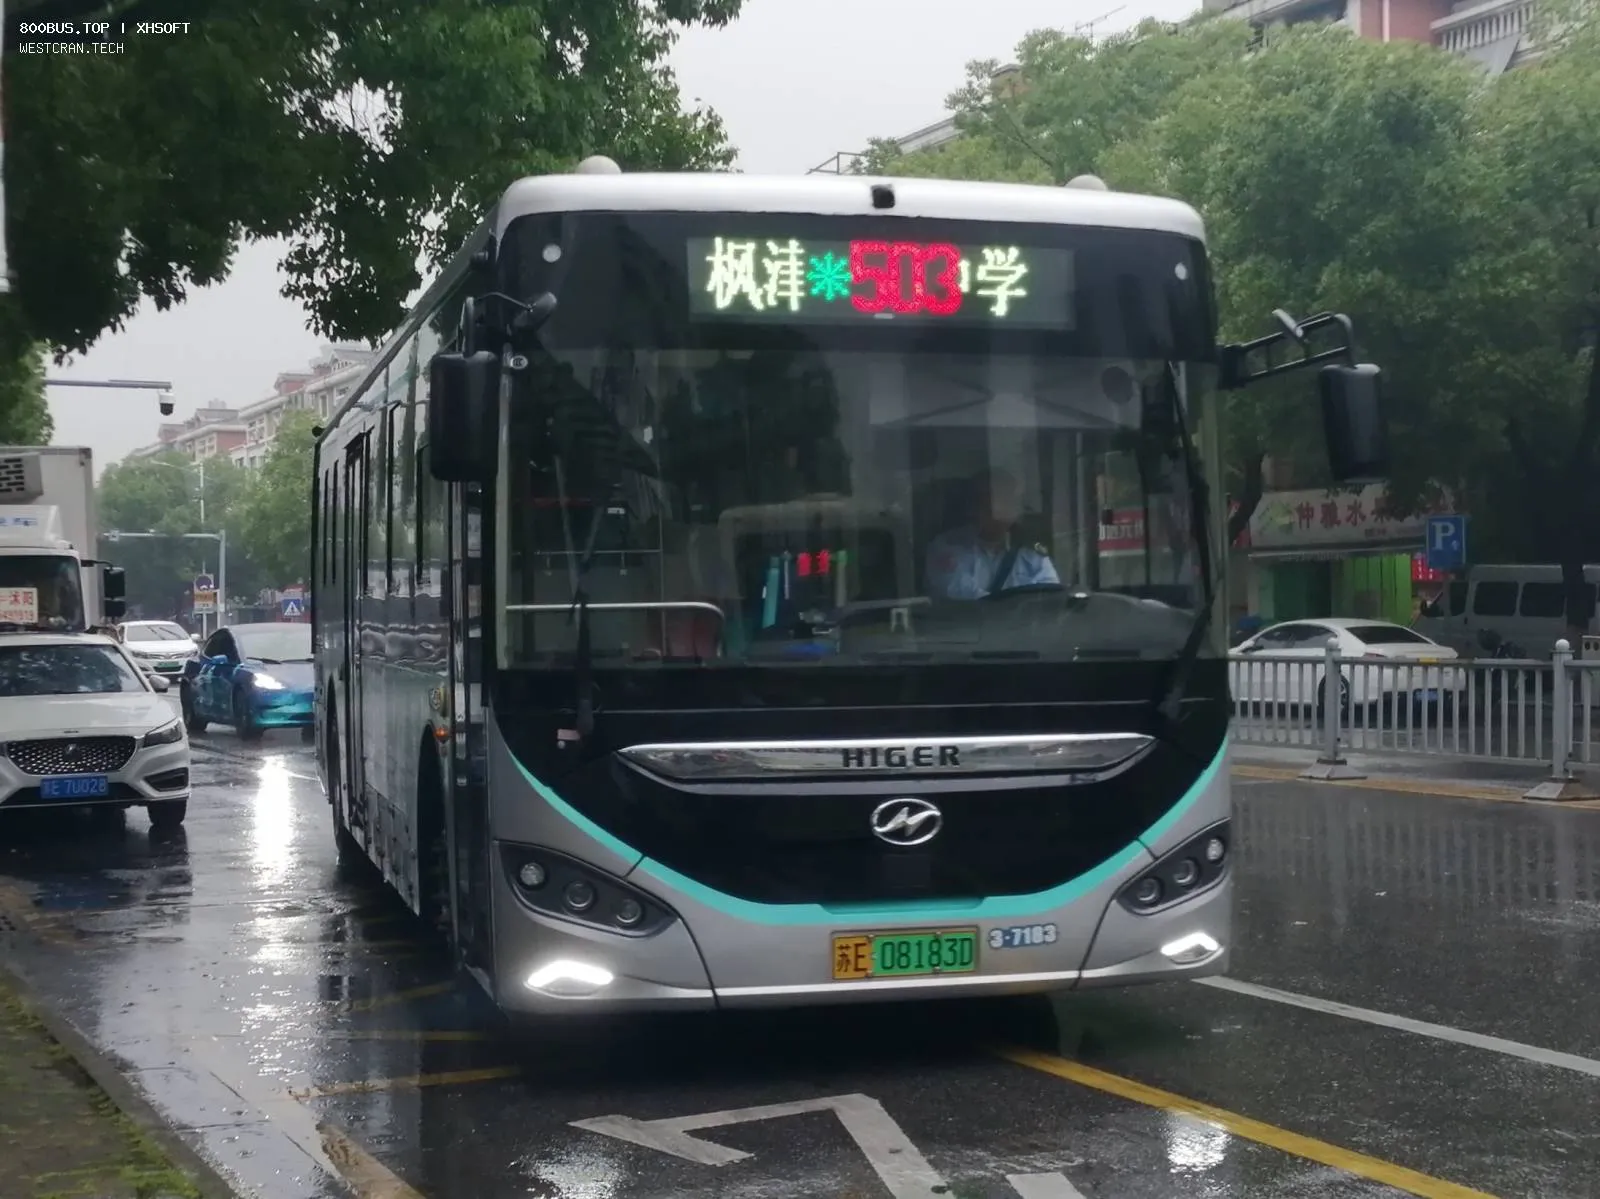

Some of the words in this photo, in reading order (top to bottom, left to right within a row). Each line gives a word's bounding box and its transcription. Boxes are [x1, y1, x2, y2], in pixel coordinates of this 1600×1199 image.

[849, 239, 963, 317] 503
[1432, 520, 1455, 550] P
[842, 744, 961, 768] HIGER
[836, 941, 868, 973] 苏E
[880, 937, 975, 972] 08183D
